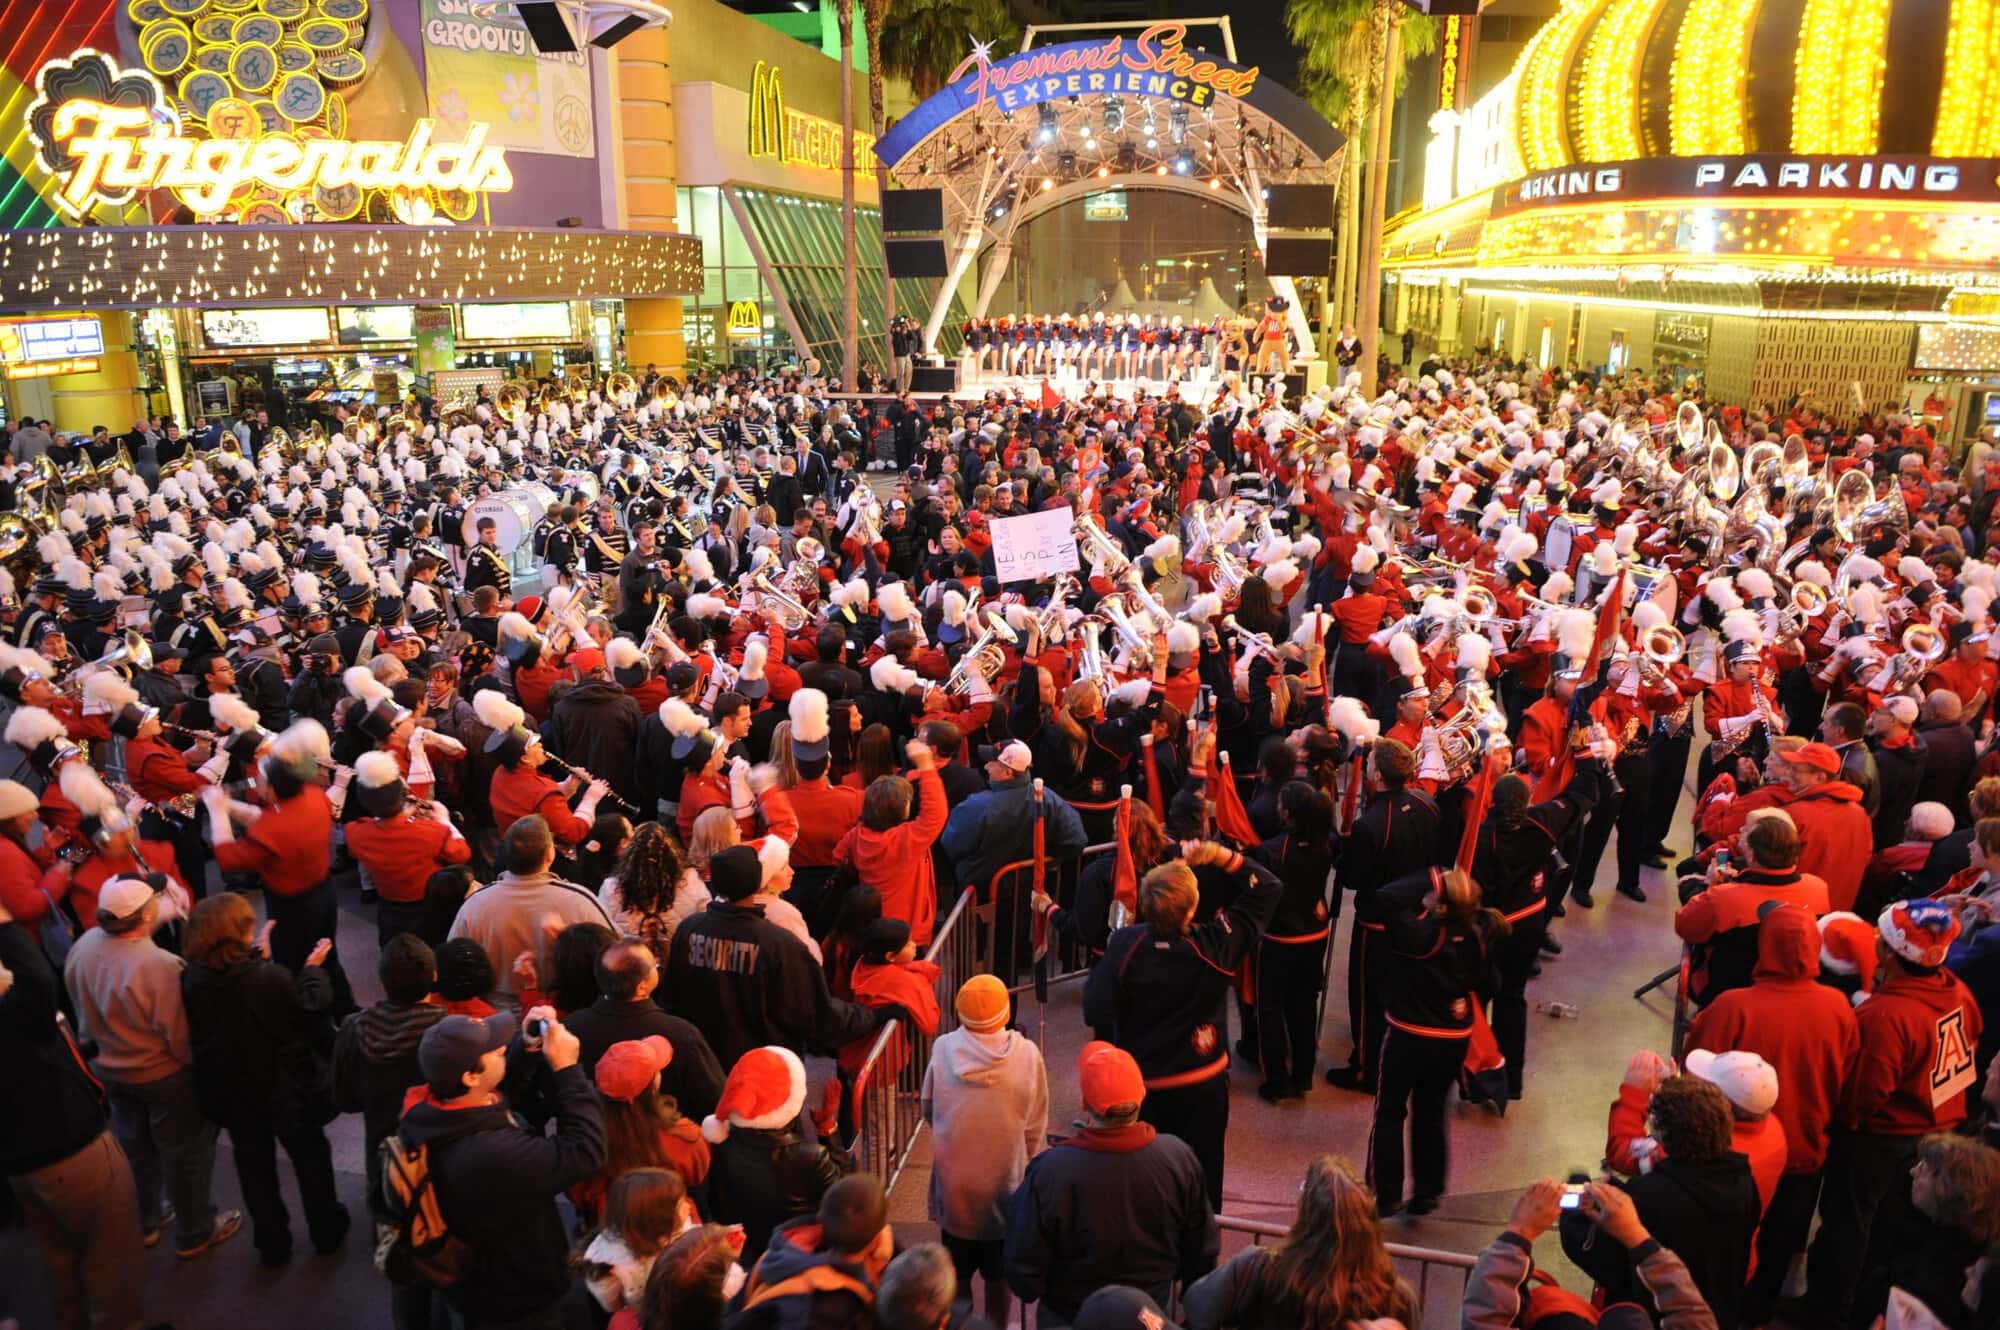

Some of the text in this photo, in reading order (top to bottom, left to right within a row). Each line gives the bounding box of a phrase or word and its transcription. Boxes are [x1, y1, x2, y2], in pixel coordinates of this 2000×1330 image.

[426, 19, 526, 56] GROOVY
[948, 23, 1259, 112] Fremont Street
[1441, 14, 1460, 110] NTRANCE
[1003, 73, 1210, 109] EXPERIENCE
[1695, 162, 1959, 191] PARKING
[688, 933, 760, 975] SECURITY
[1931, 1008, 1973, 1088] A
